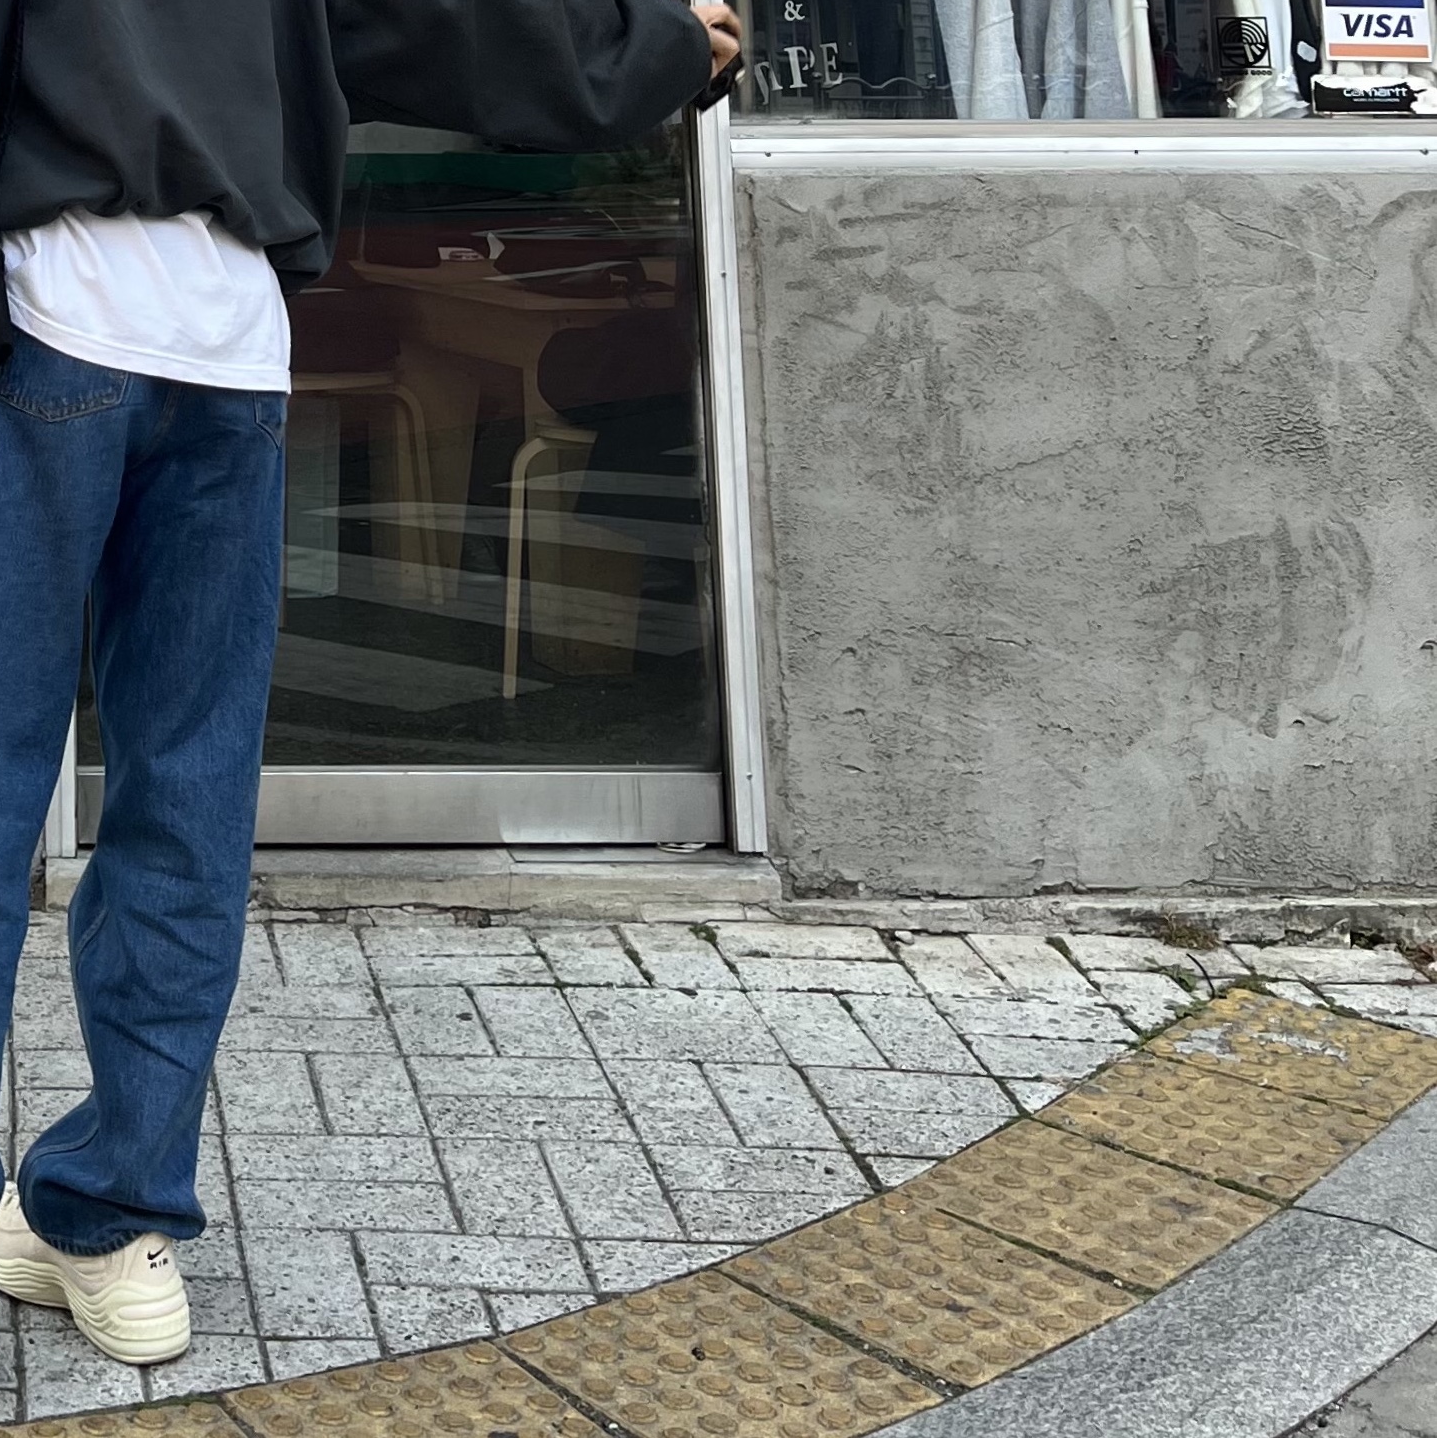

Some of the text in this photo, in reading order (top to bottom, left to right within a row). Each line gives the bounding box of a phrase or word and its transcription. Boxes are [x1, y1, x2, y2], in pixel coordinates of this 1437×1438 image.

[784, 0, 805, 21] &
[1340, 14, 1414, 38] VISA
[149, 1257, 169, 1269] AIR
